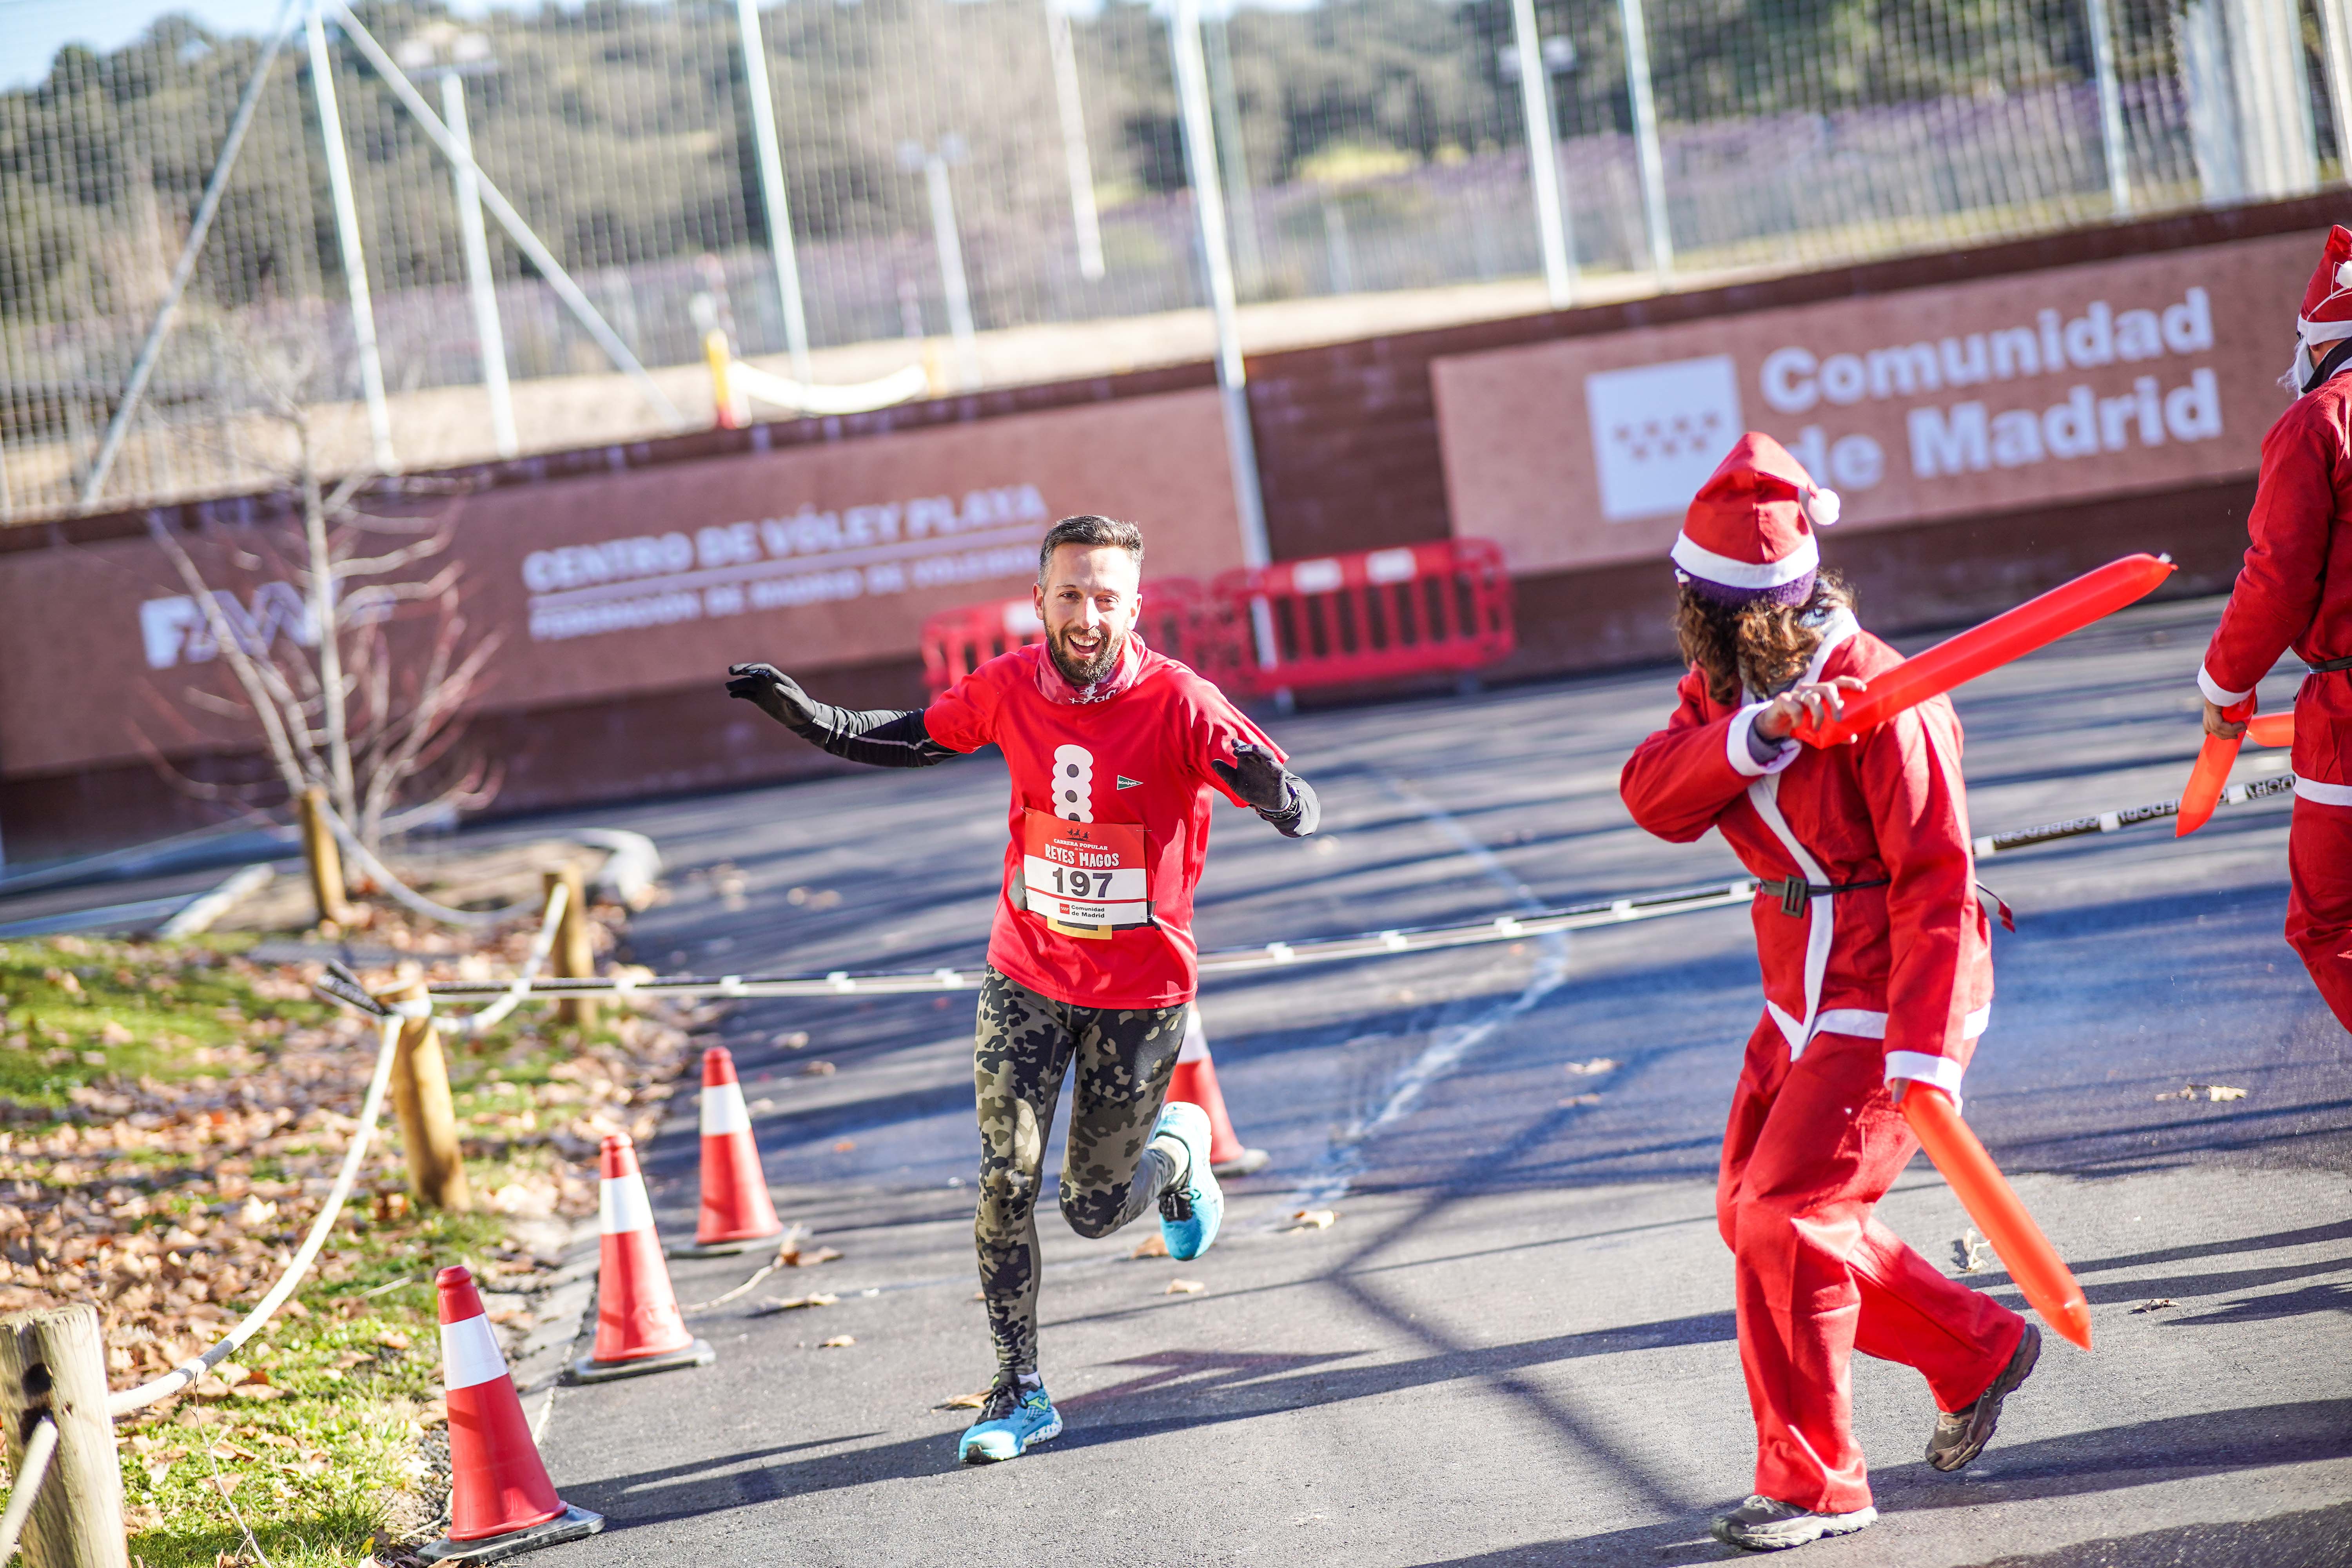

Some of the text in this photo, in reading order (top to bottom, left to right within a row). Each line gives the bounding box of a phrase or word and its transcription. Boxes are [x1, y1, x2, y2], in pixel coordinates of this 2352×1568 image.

[1759, 286, 2215, 415] Comunidad
[1906, 367, 2223, 479] Madrid
[522, 531, 693, 593] CENTRO
[695, 521, 764, 568] DE
[906, 484, 1049, 540] PLAYA
[1045, 843, 1120, 867] REYES MAGOS
[1053, 838, 1108, 851] CARRERA POPULAR
[1053, 867, 1113, 898] 197
